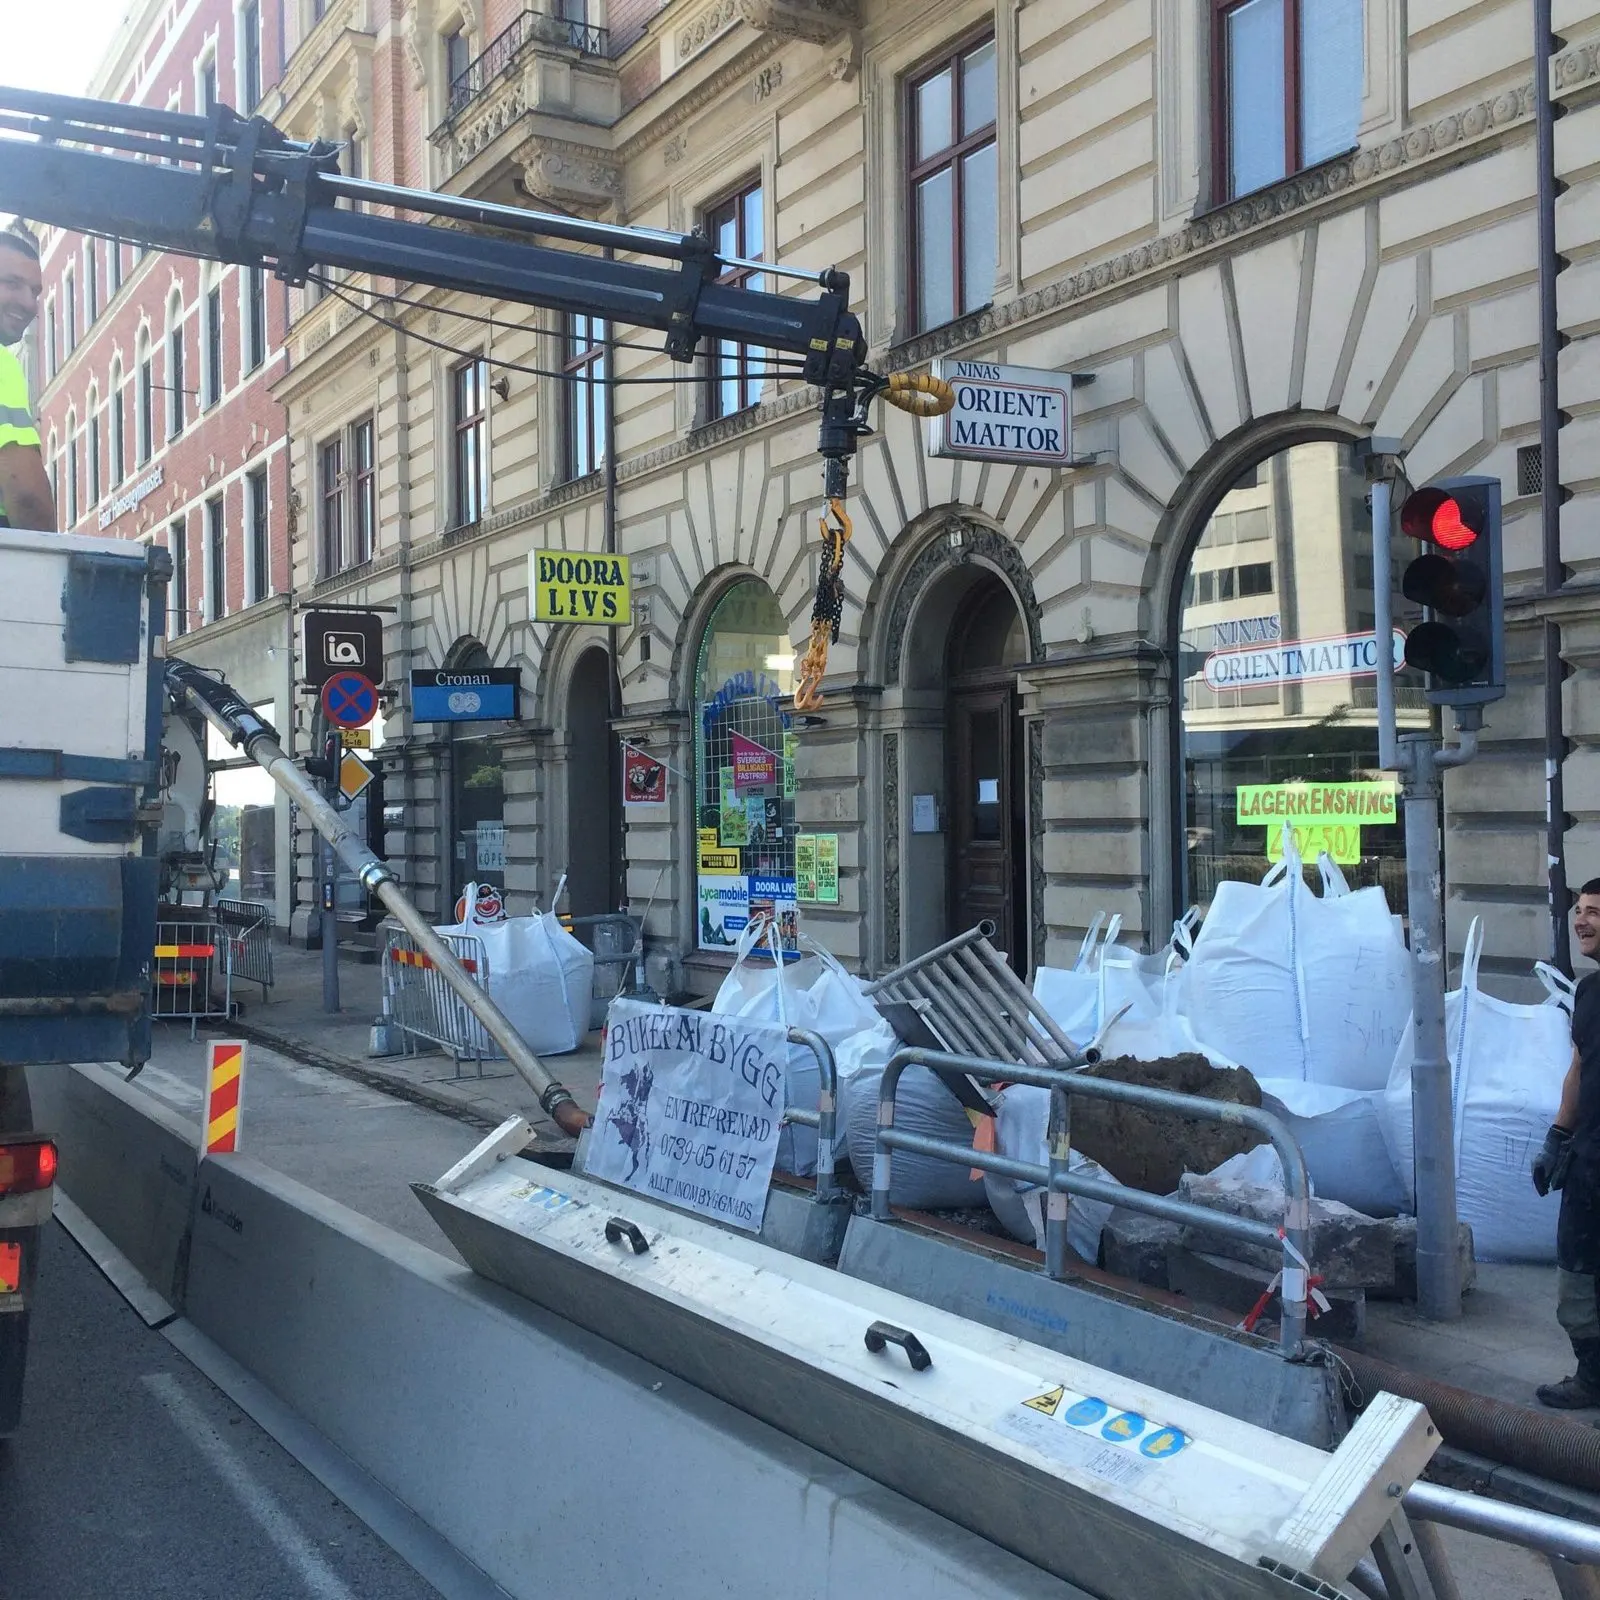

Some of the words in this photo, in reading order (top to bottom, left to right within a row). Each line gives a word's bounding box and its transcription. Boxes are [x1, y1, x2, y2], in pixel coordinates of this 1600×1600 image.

[956, 362, 1000, 380] NINAS
[958, 386, 1057, 419] ORIENT-
[954, 420, 1060, 452] MATTOR
[539, 557, 625, 586] DOORA
[548, 589, 617, 618] LIVS
[1212, 614, 1282, 646] NINAS
[1213, 637, 1398, 683] ORIENTMATTO
[435, 672, 491, 686] Cronan
[344, 730, 360, 738] 7-9
[737, 763, 773, 772] BILLIGASTE
[1240, 788, 1394, 817] LAGERRENSNING
[699, 885, 748, 901] Lycamobile
[755, 882, 780, 892] DOORA
[781, 883, 797, 893] LIVS
[611, 1014, 704, 1062] BUKEFAL
[709, 1024, 782, 1108] BYGG
[664, 1096, 771, 1142] ENTREPRENAD
[660, 1133, 717, 1169] 0739-05
[719, 1150, 734, 1175] 61
[735, 1153, 757, 1180] 57
[648, 1172, 674, 1194] ALLT
